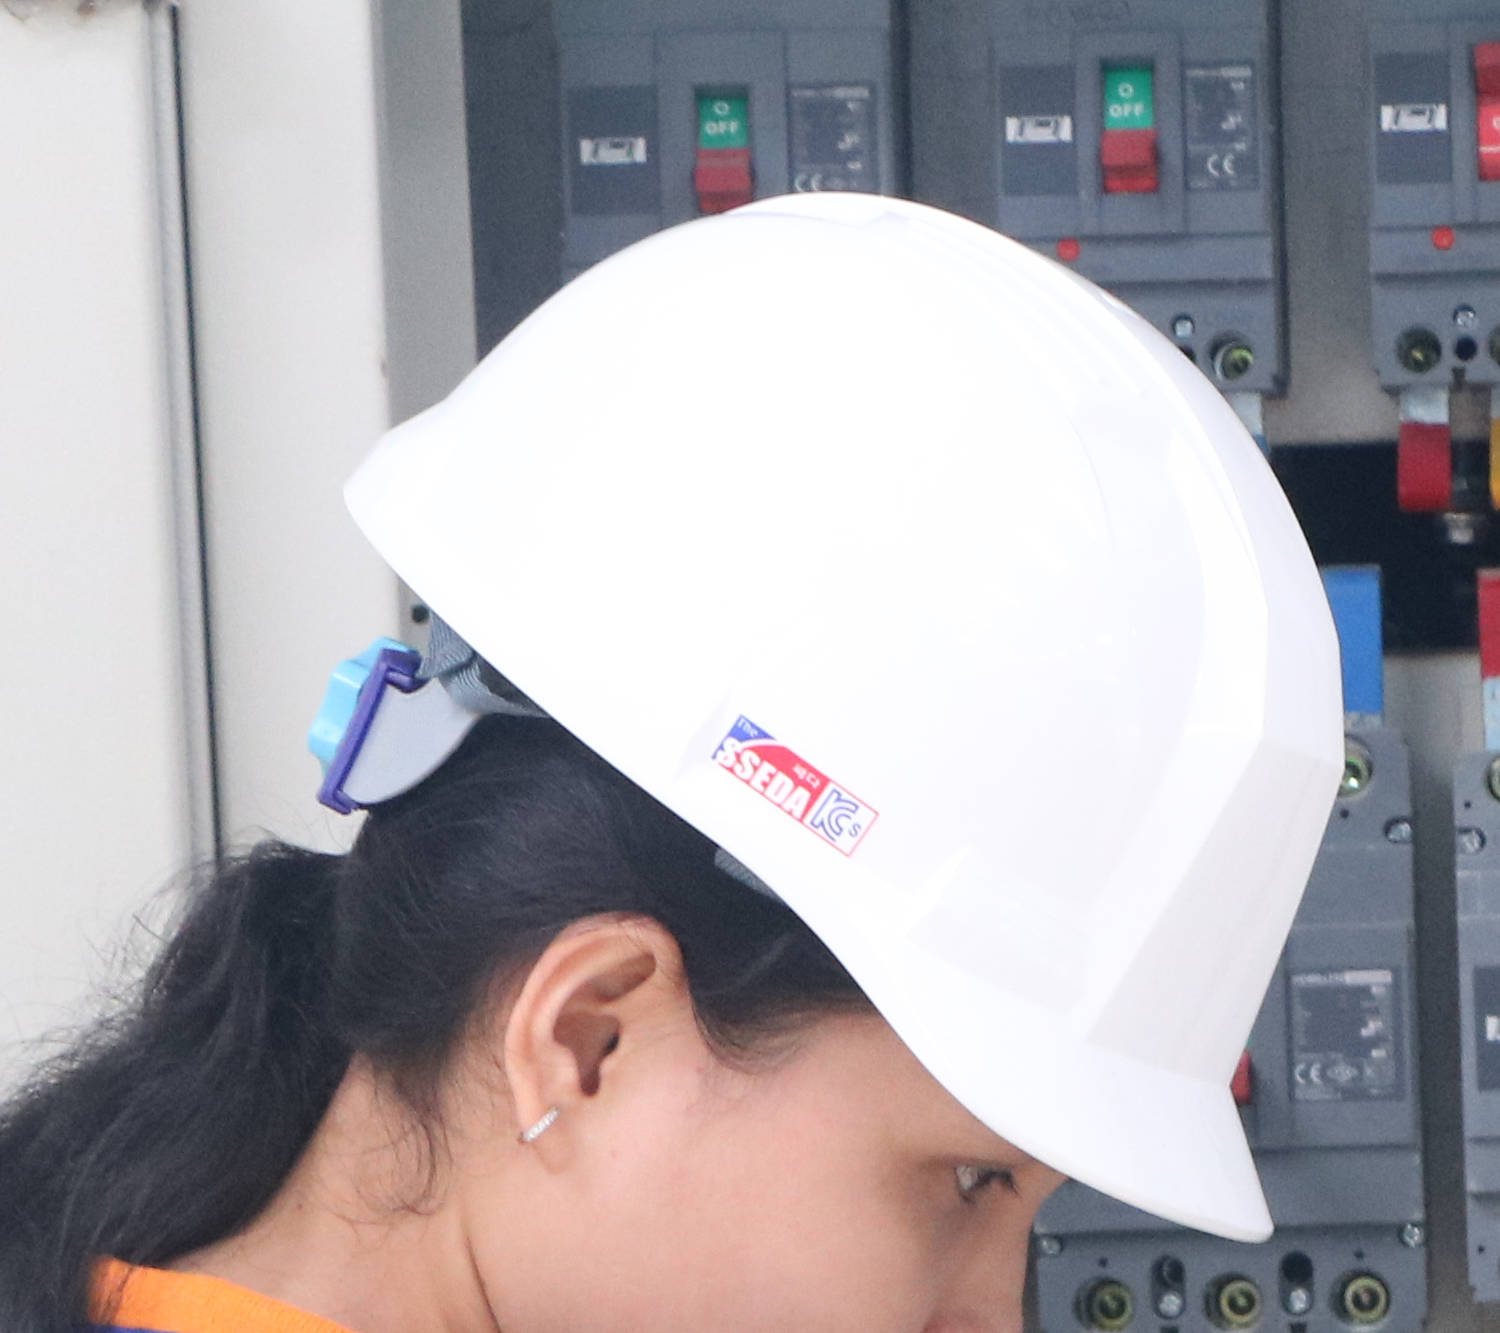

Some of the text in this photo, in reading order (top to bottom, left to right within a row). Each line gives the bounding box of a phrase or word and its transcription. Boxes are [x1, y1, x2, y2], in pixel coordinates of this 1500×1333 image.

[1108, 102, 1145, 119] OFF
[705, 119, 741, 135] OFF
[714, 735, 813, 821] SSEDA
